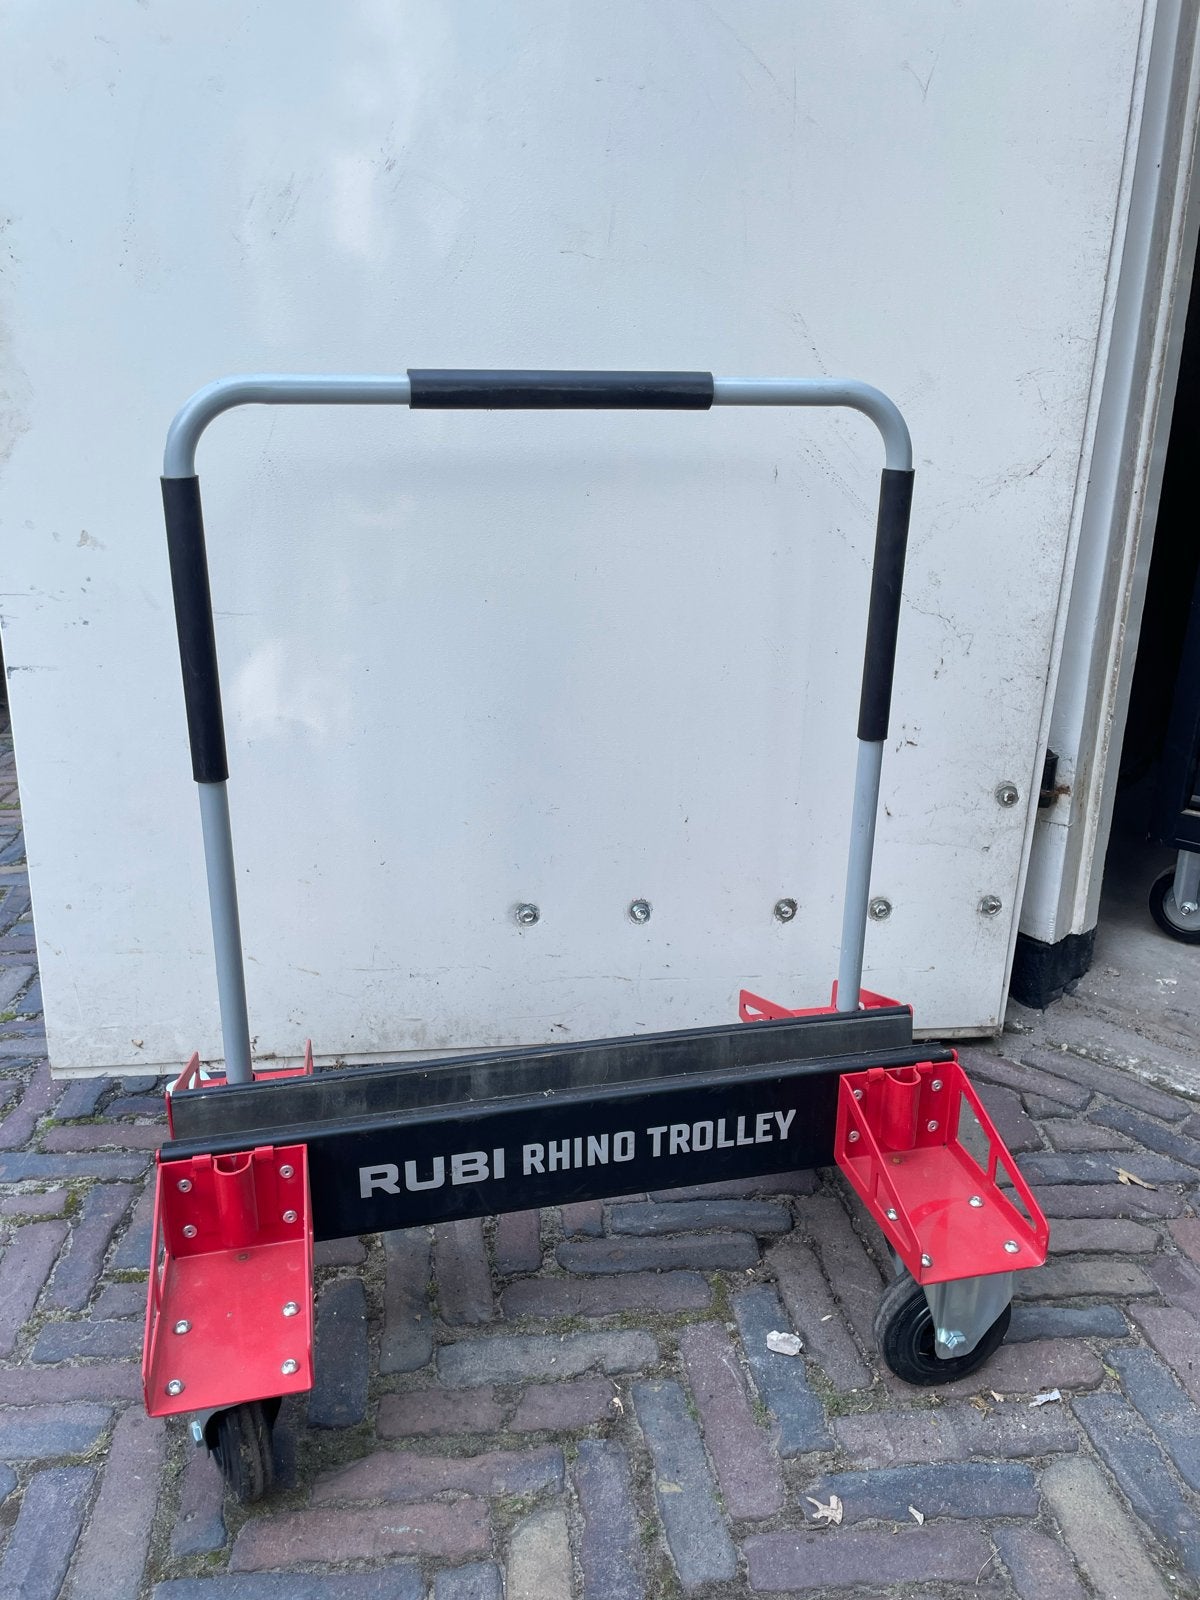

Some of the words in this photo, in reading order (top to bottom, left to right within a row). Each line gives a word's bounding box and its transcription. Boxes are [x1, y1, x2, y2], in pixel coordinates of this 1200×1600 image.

[359, 1148, 505, 1198] RUBI
[522, 1131, 635, 1176] RHINO
[646, 1109, 797, 1157] TROLLEY
